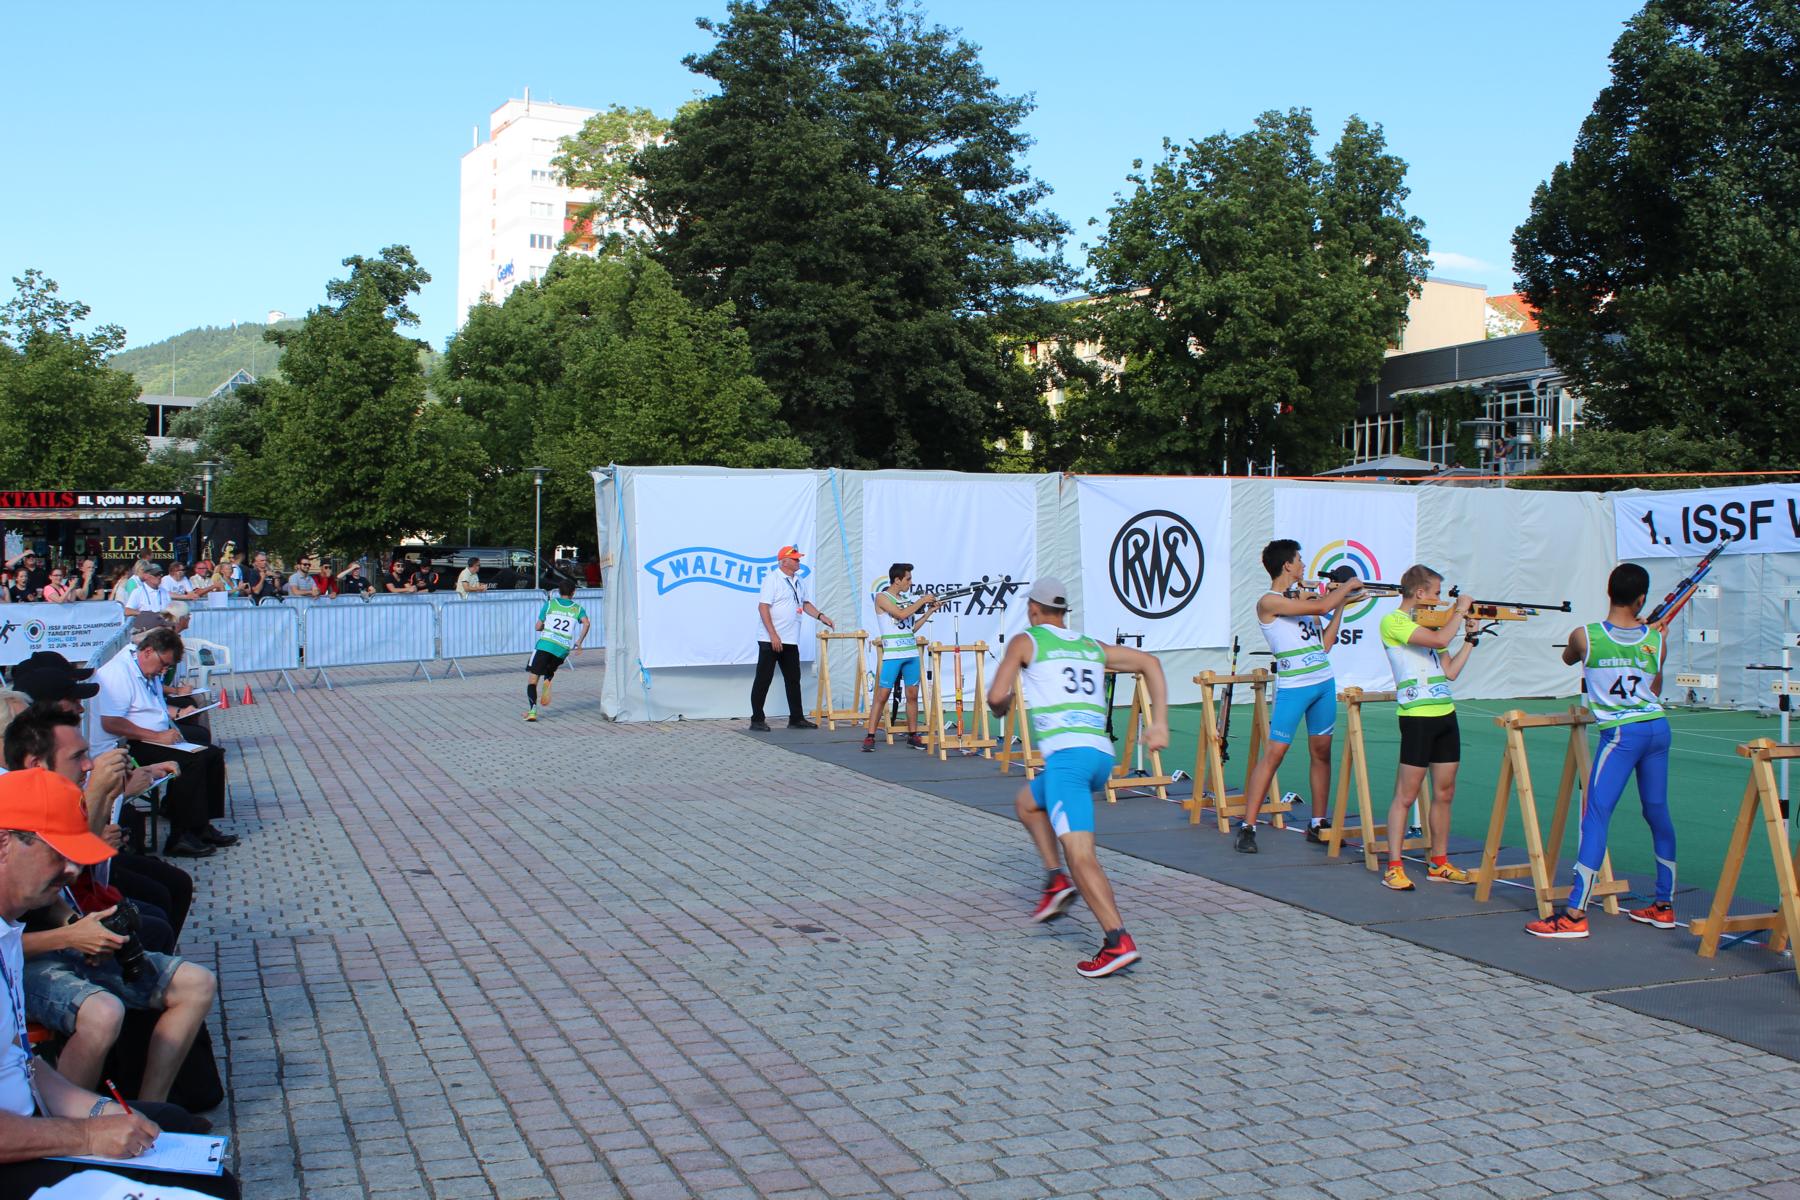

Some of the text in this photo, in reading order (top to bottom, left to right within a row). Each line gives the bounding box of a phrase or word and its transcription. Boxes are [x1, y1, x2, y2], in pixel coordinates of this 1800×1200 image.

[77, 495, 182, 507] EL RON DE CUBA
[1641, 510, 1671, 545] 1.
[1681, 498, 1775, 545] ISSF
[107, 535, 165, 552] LEIK
[1122, 521, 1191, 609] RWS
[553, 618, 570, 632] 22
[1333, 629, 1363, 645] SF
[1700, 630, 1706, 642] 1
[1062, 667, 1096, 695] 35
[1609, 675, 1642, 699] 47
